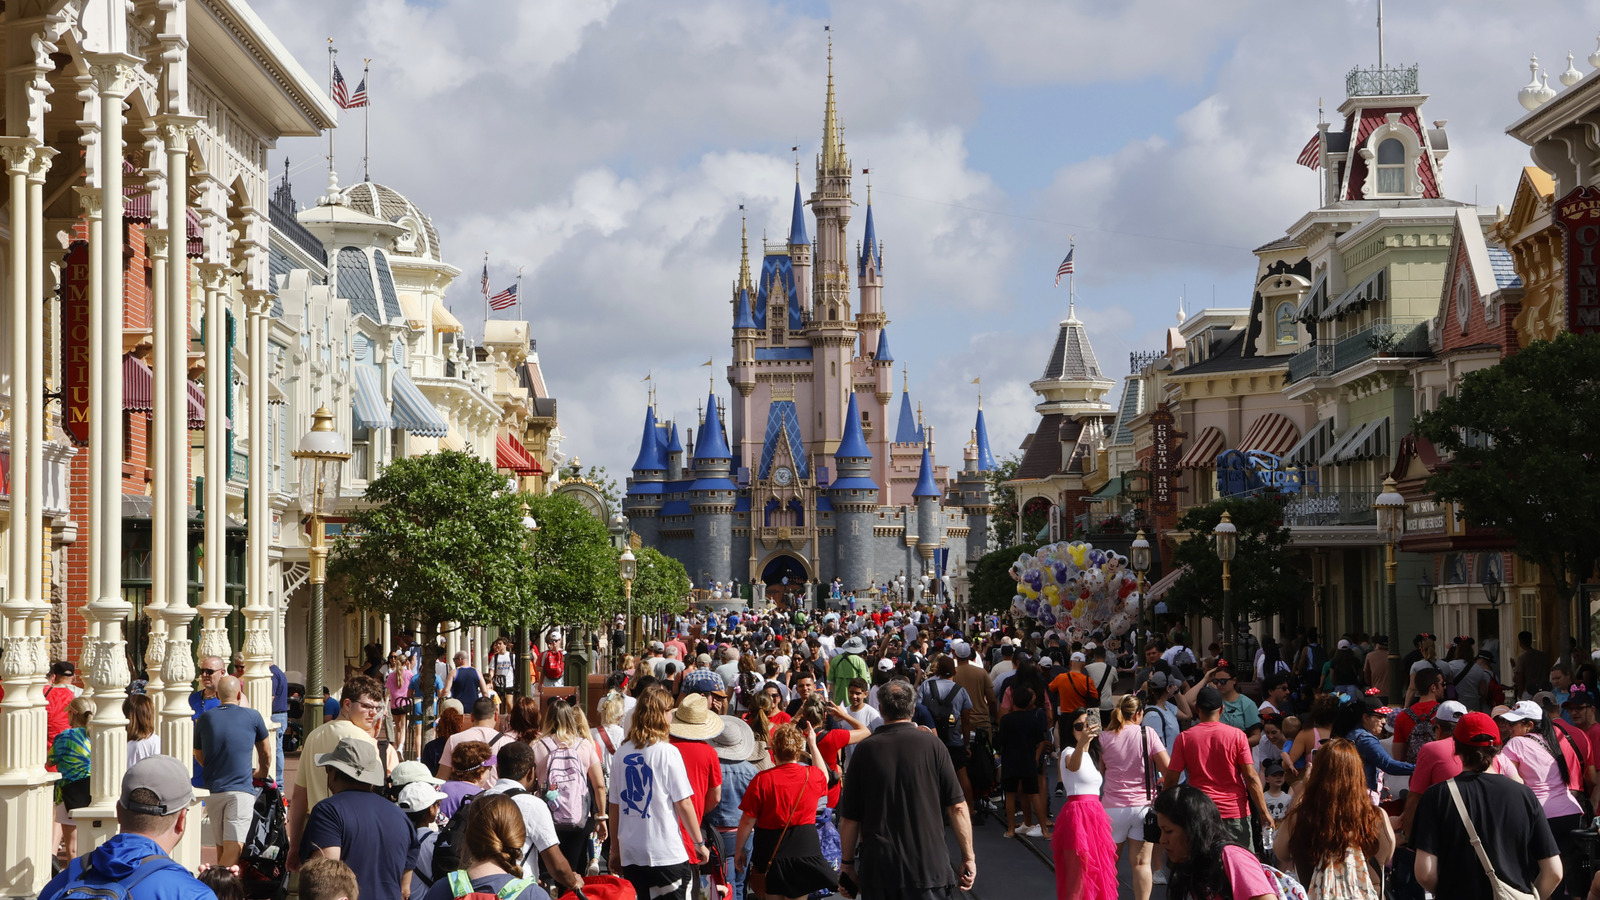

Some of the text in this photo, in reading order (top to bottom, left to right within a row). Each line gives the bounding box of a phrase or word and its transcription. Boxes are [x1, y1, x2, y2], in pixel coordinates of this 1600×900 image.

[69, 263, 89, 423] EMPORIUM
[1157, 424, 1168, 502] CRYSTAL ARTS
